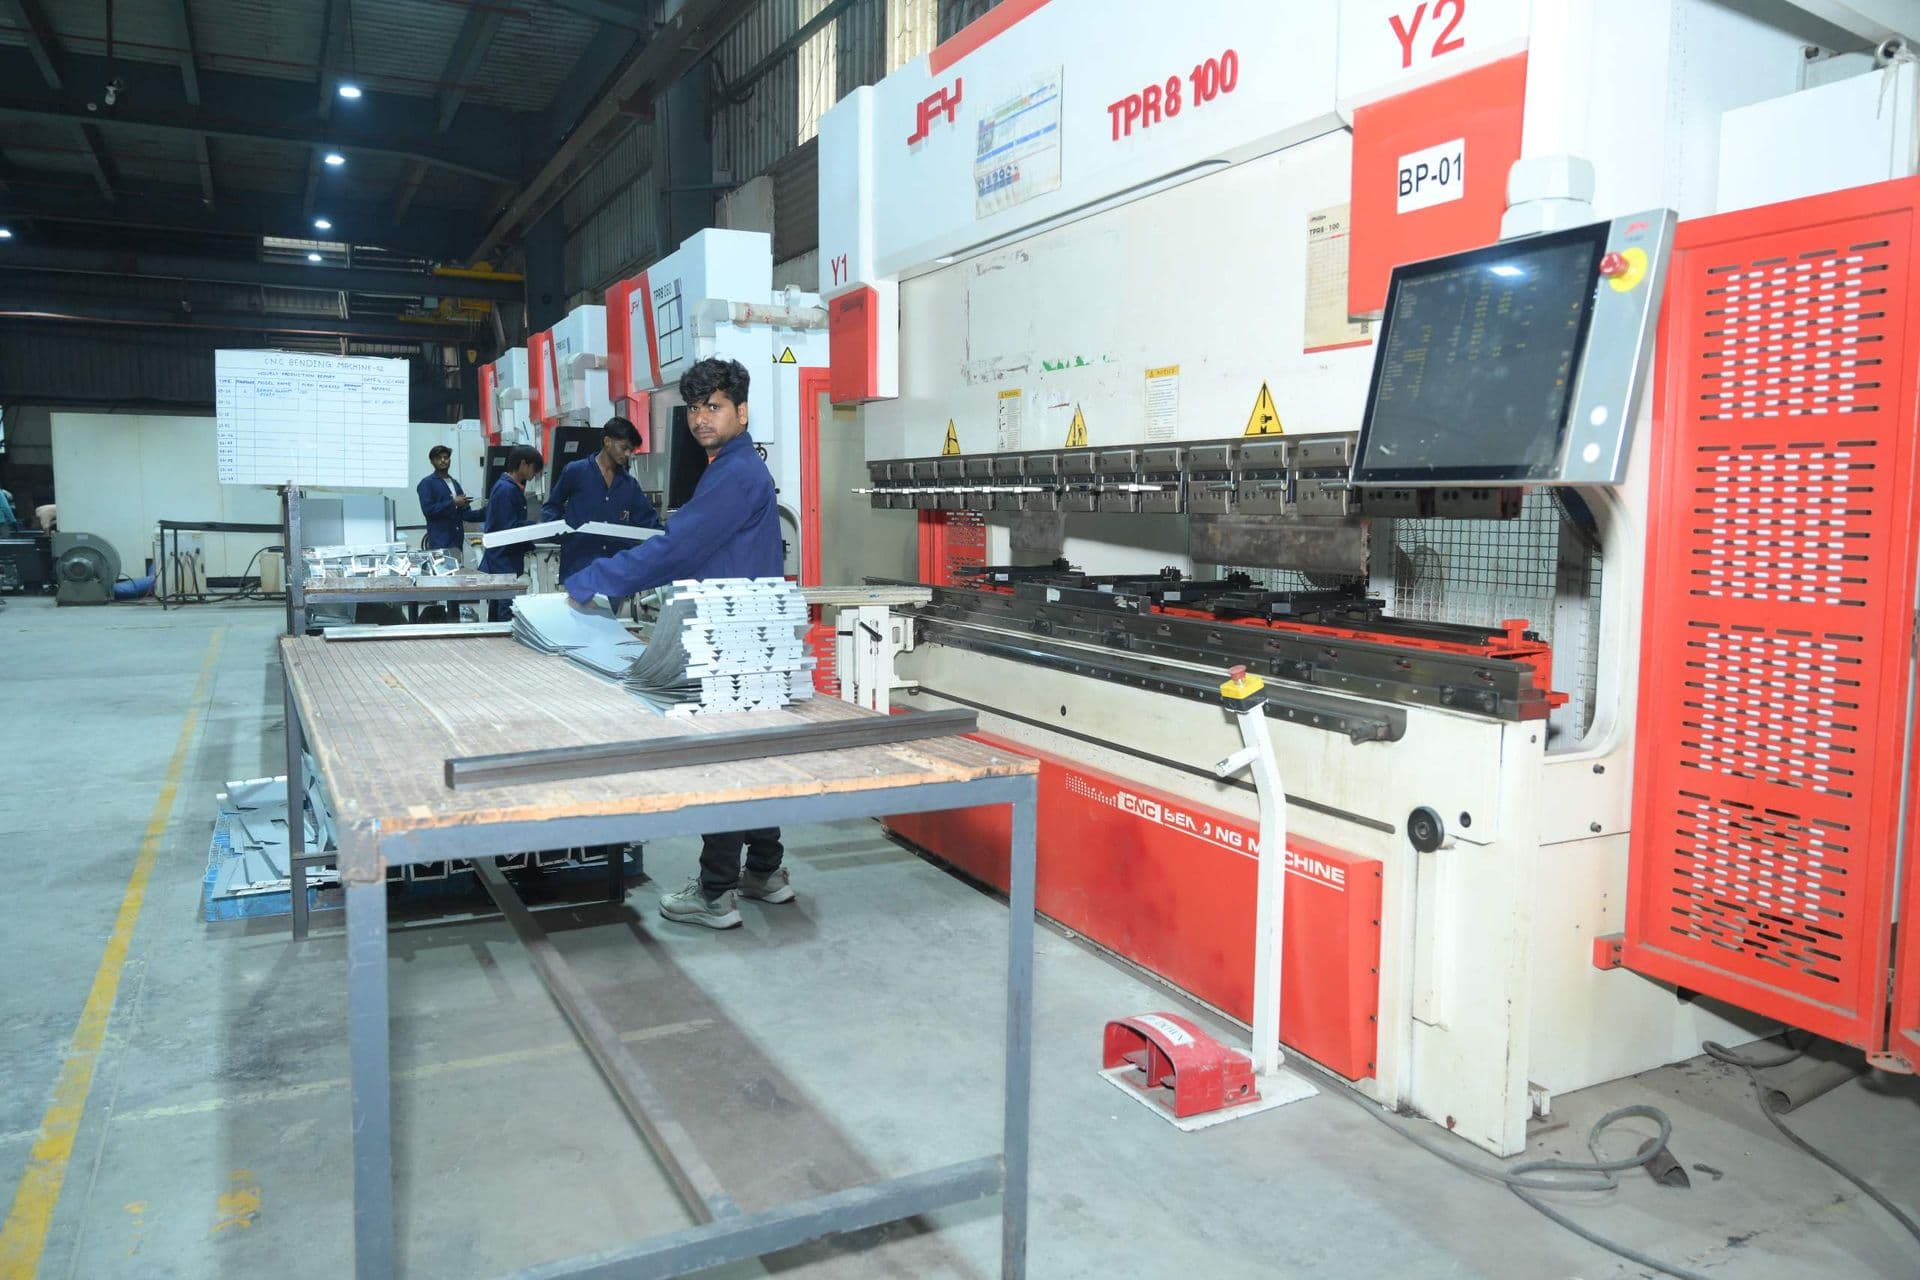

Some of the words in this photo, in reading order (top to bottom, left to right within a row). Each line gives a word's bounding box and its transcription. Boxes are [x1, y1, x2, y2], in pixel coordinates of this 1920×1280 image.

[1388, 0, 1466, 68] Y2
[1107, 75, 1182, 141] TPR8
[1189, 48, 1239, 107] 100
[1399, 152, 1462, 197] BP-01
[831, 253, 847, 286] Y1
[1121, 793, 1159, 820] CNC
[1248, 837, 1345, 885] MCHINE
